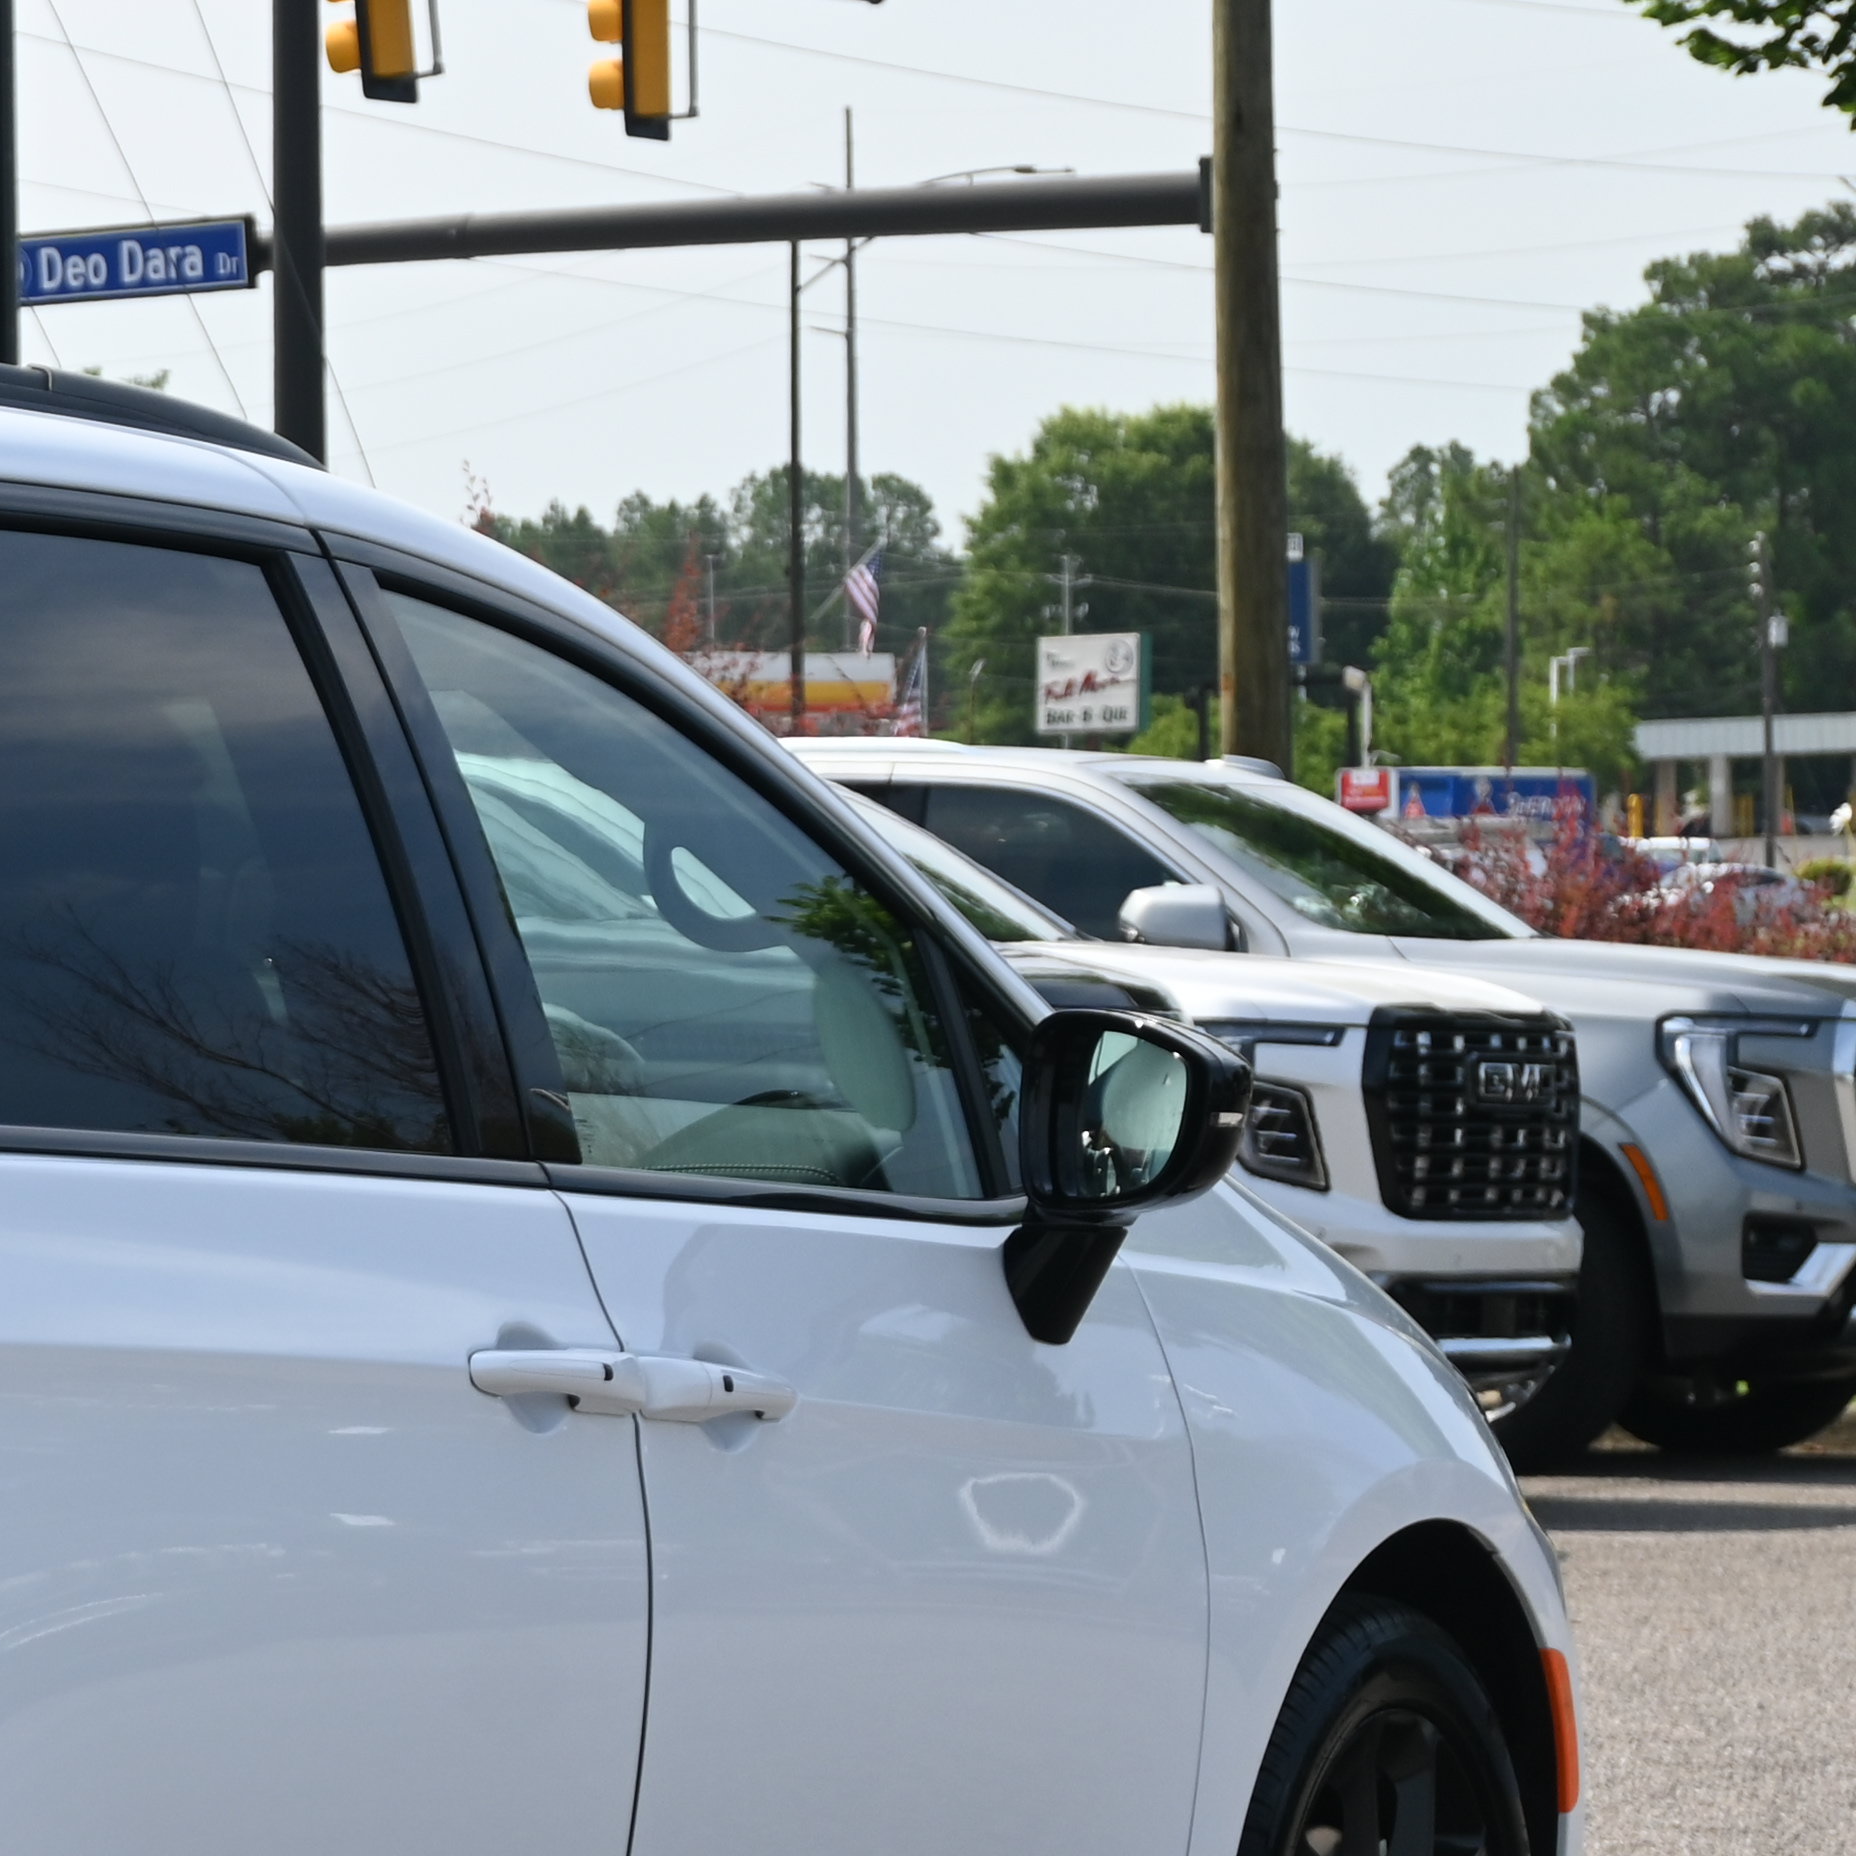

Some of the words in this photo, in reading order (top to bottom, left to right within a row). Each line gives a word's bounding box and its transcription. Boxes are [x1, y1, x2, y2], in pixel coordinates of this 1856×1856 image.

[39, 246, 108, 290] Deo
[117, 239, 204, 284] Dara
[215, 251, 239, 276] Dr
